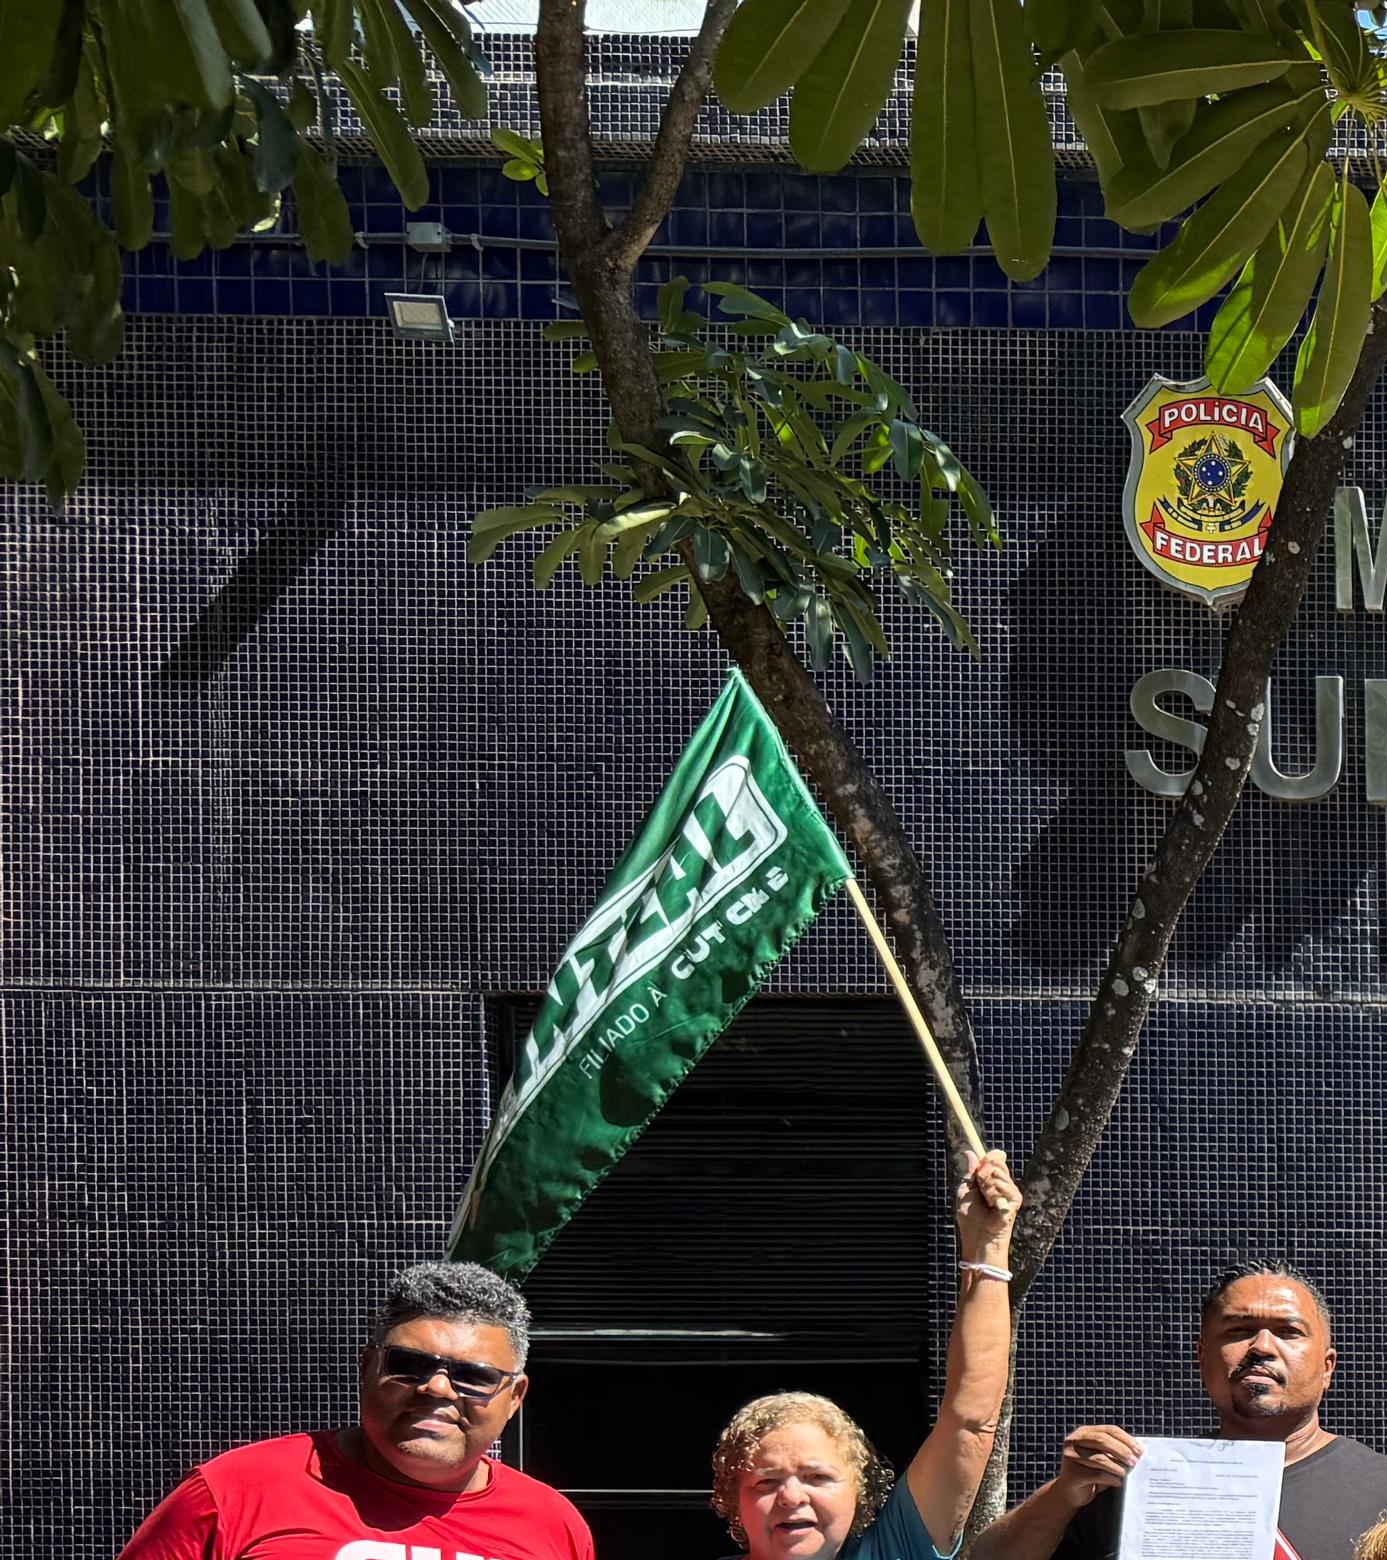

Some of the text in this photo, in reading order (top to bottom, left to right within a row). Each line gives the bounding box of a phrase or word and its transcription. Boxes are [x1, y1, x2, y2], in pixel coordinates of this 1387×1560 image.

[1164, 401, 1264, 433] POLÍCIA
[1155, 529, 1264, 564] FEDERAL
[579, 1003, 649, 1079] FILIADO
[671, 919, 726, 980] CUT
